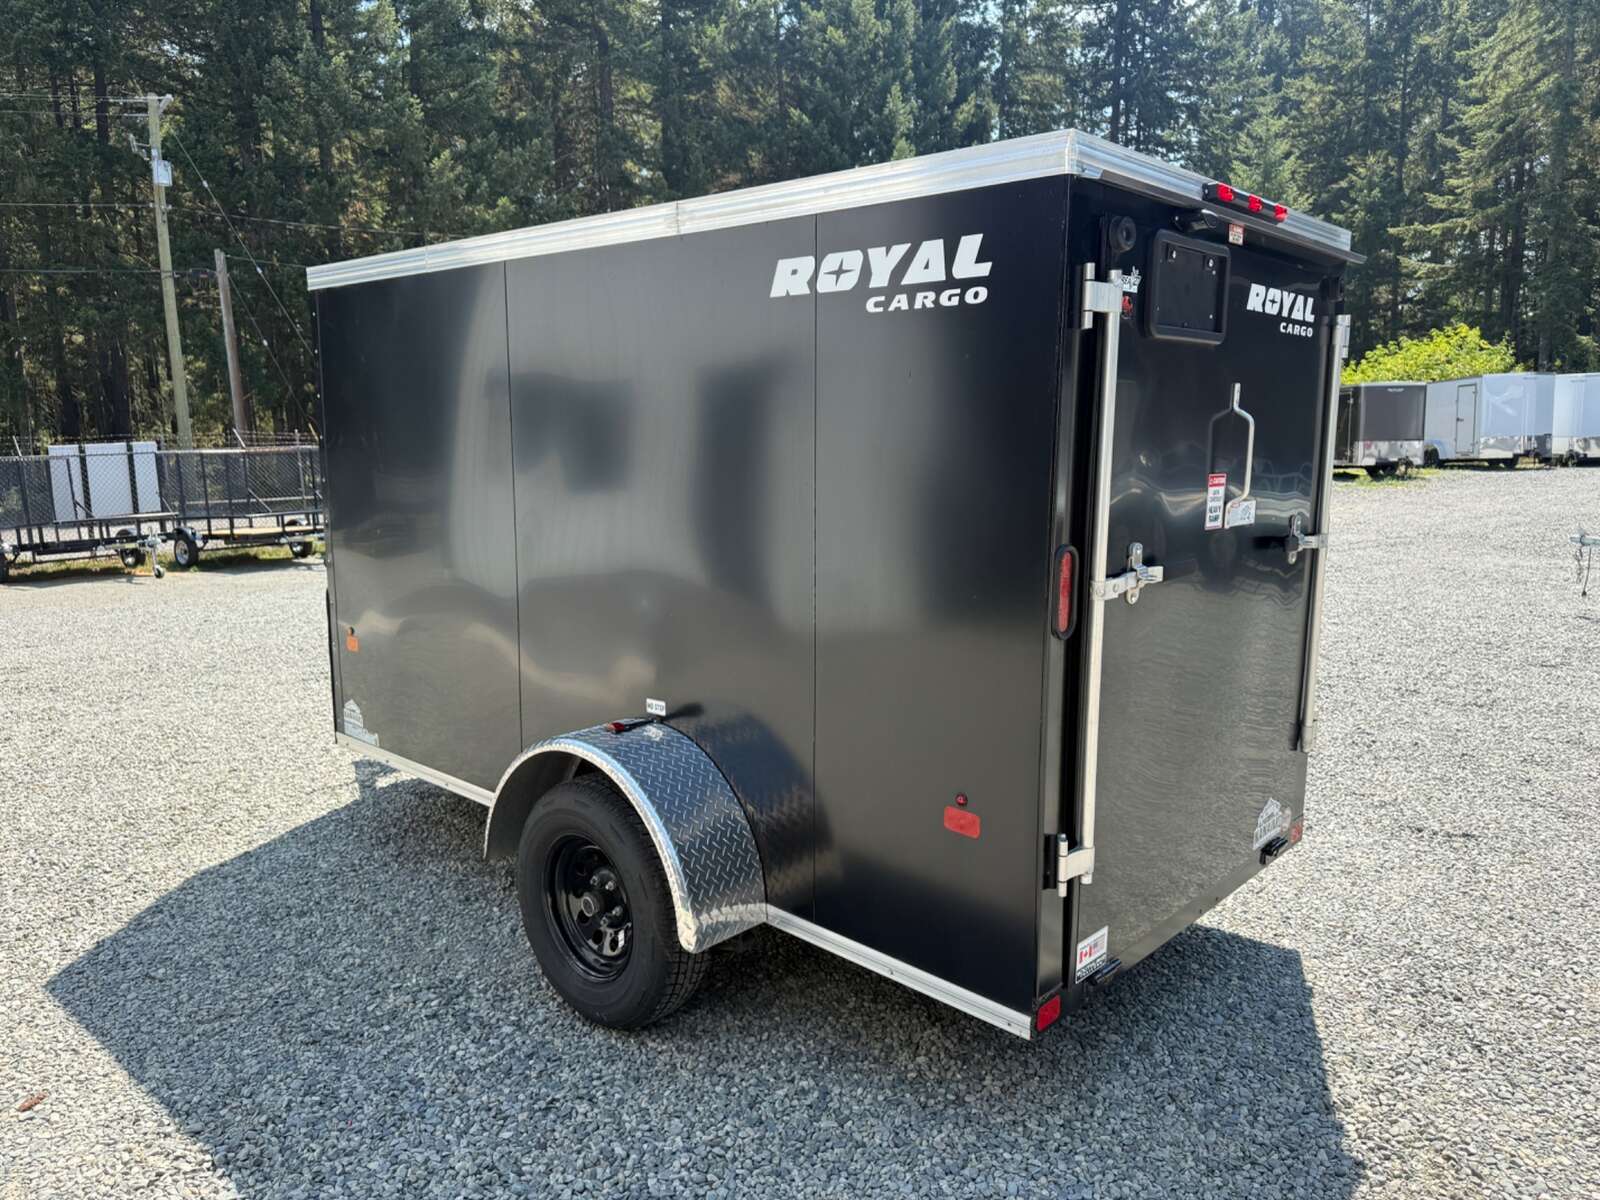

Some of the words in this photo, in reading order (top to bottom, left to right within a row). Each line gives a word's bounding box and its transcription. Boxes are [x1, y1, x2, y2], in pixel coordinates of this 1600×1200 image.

[769, 233, 993, 298] ROYAL
[865, 286, 988, 313] CARGO
[1246, 283, 1315, 323] ROYAL
[1280, 322, 1313, 338] CARGO
